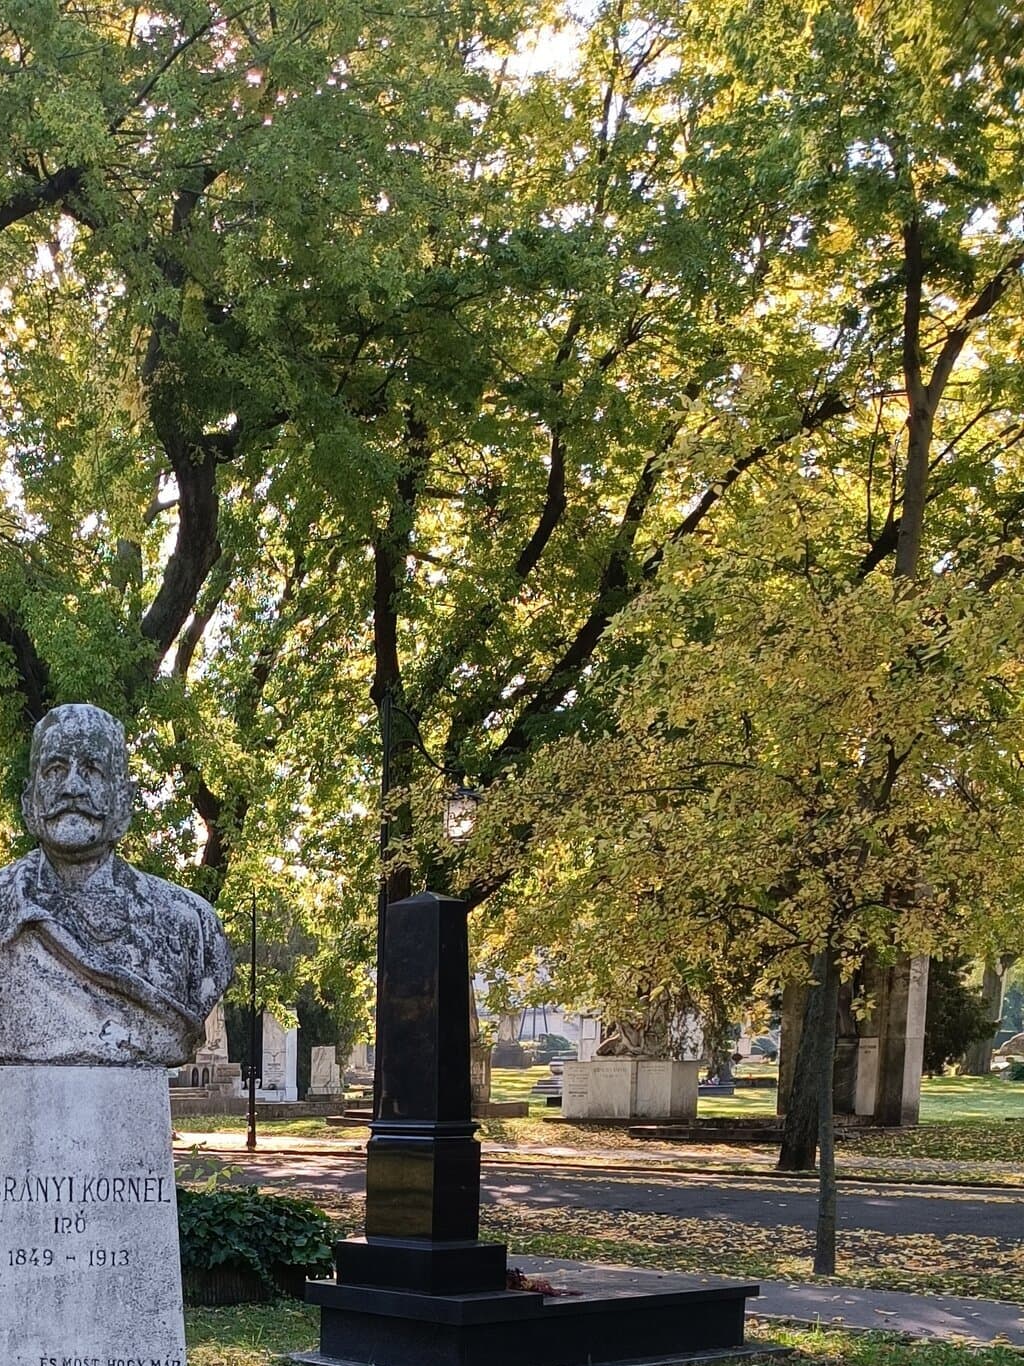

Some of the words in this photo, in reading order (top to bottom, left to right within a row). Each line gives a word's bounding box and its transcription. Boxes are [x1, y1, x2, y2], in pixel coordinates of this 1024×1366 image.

[81, 1168, 171, 1203] KORNÉL
[54, 1210, 87, 1234] IRÓ
[8, 1248, 54, 1266] 1849
[88, 1249, 130, 1267] 1913
